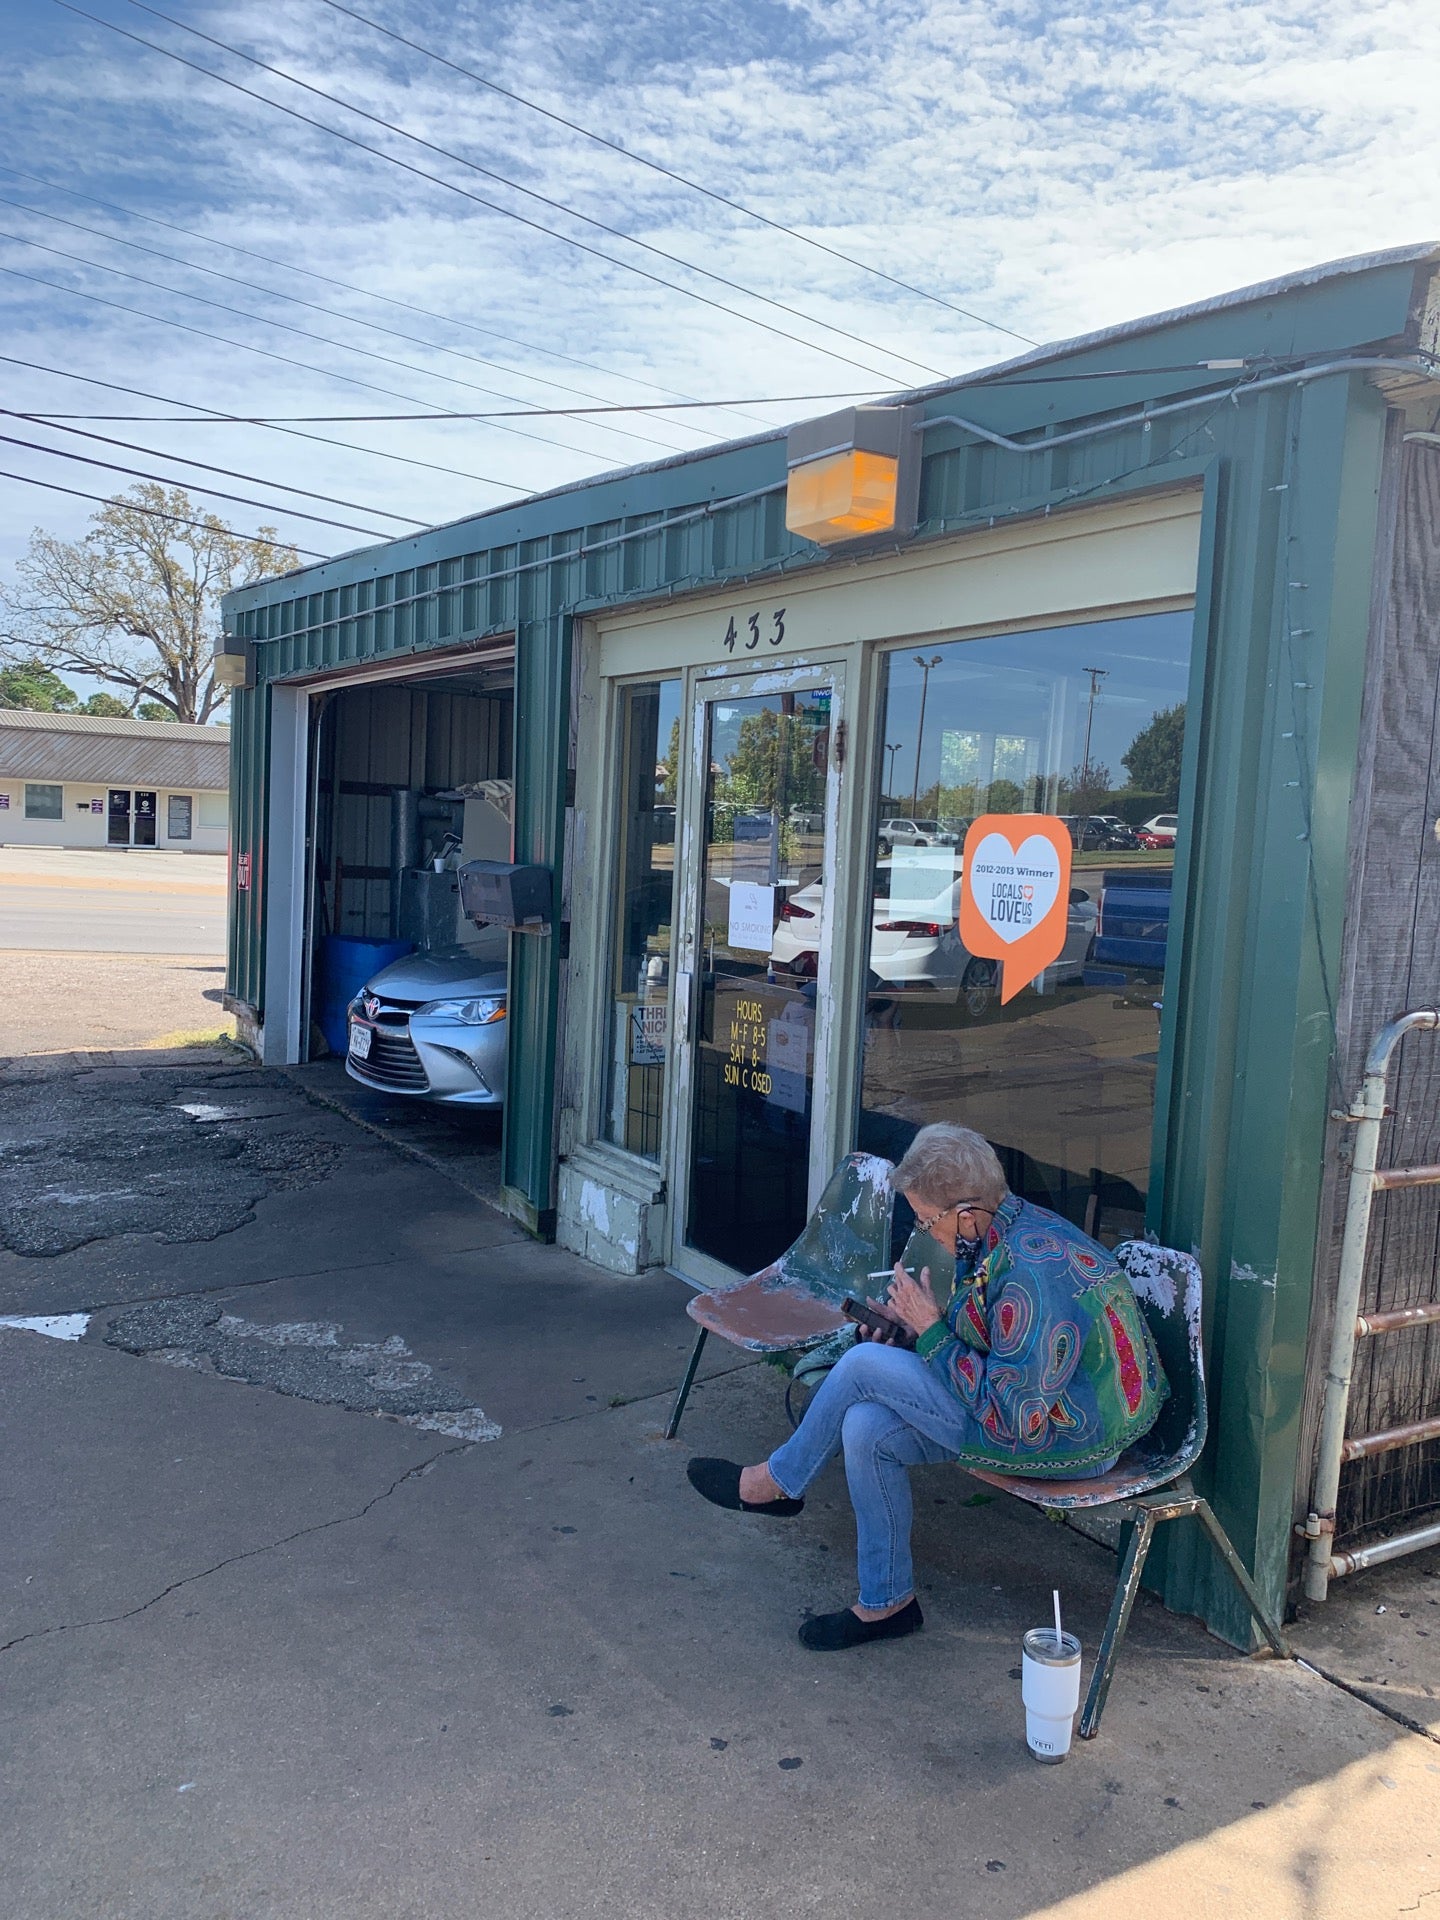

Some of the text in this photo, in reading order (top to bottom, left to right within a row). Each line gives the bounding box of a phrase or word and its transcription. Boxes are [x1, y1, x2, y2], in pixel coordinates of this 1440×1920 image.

[724, 608, 786, 653] 433
[976, 864, 1055, 878] 2012-2013 Winner
[991, 882, 1024, 900] LOCALS
[990, 898, 1033, 924] LOVE US
[741, 922, 772, 935] SMOKING
[736, 999, 762, 1023] HOURS
[730, 1020, 766, 1047] M-F 8-5
[730, 1043, 746, 1064] SAT
[724, 1063, 740, 1086] SUN
[1035, 1739, 1051, 1749] YETI
